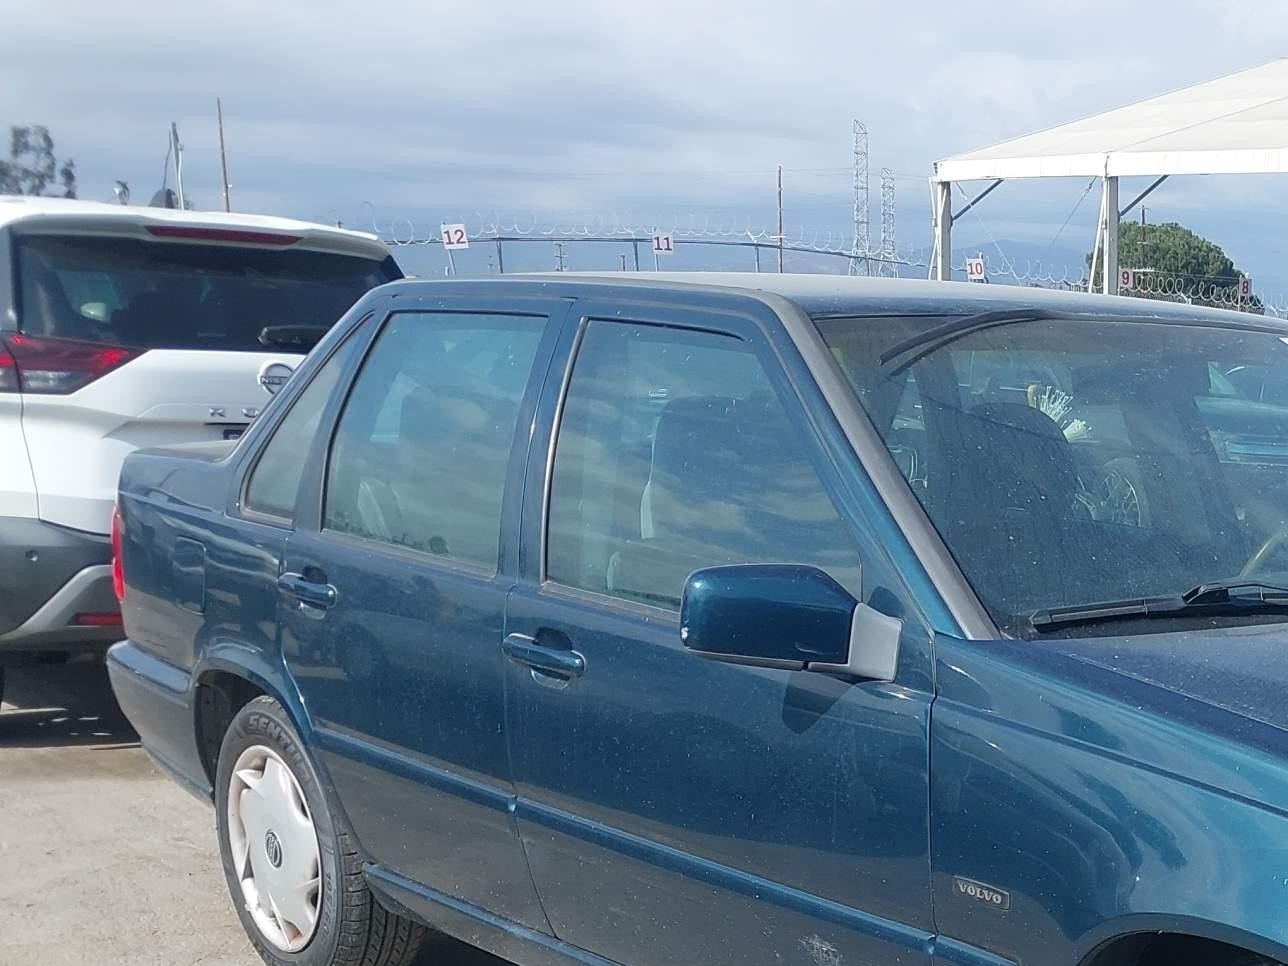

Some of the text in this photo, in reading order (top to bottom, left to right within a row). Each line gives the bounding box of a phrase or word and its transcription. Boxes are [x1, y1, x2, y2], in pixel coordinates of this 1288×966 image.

[443, 229, 467, 245] 12
[653, 236, 673, 251] 11
[968, 263, 983, 275] 10
[1122, 271, 1130, 285] 9
[1242, 280, 1249, 294] 8
[957, 880, 1002, 904] VOLVO
